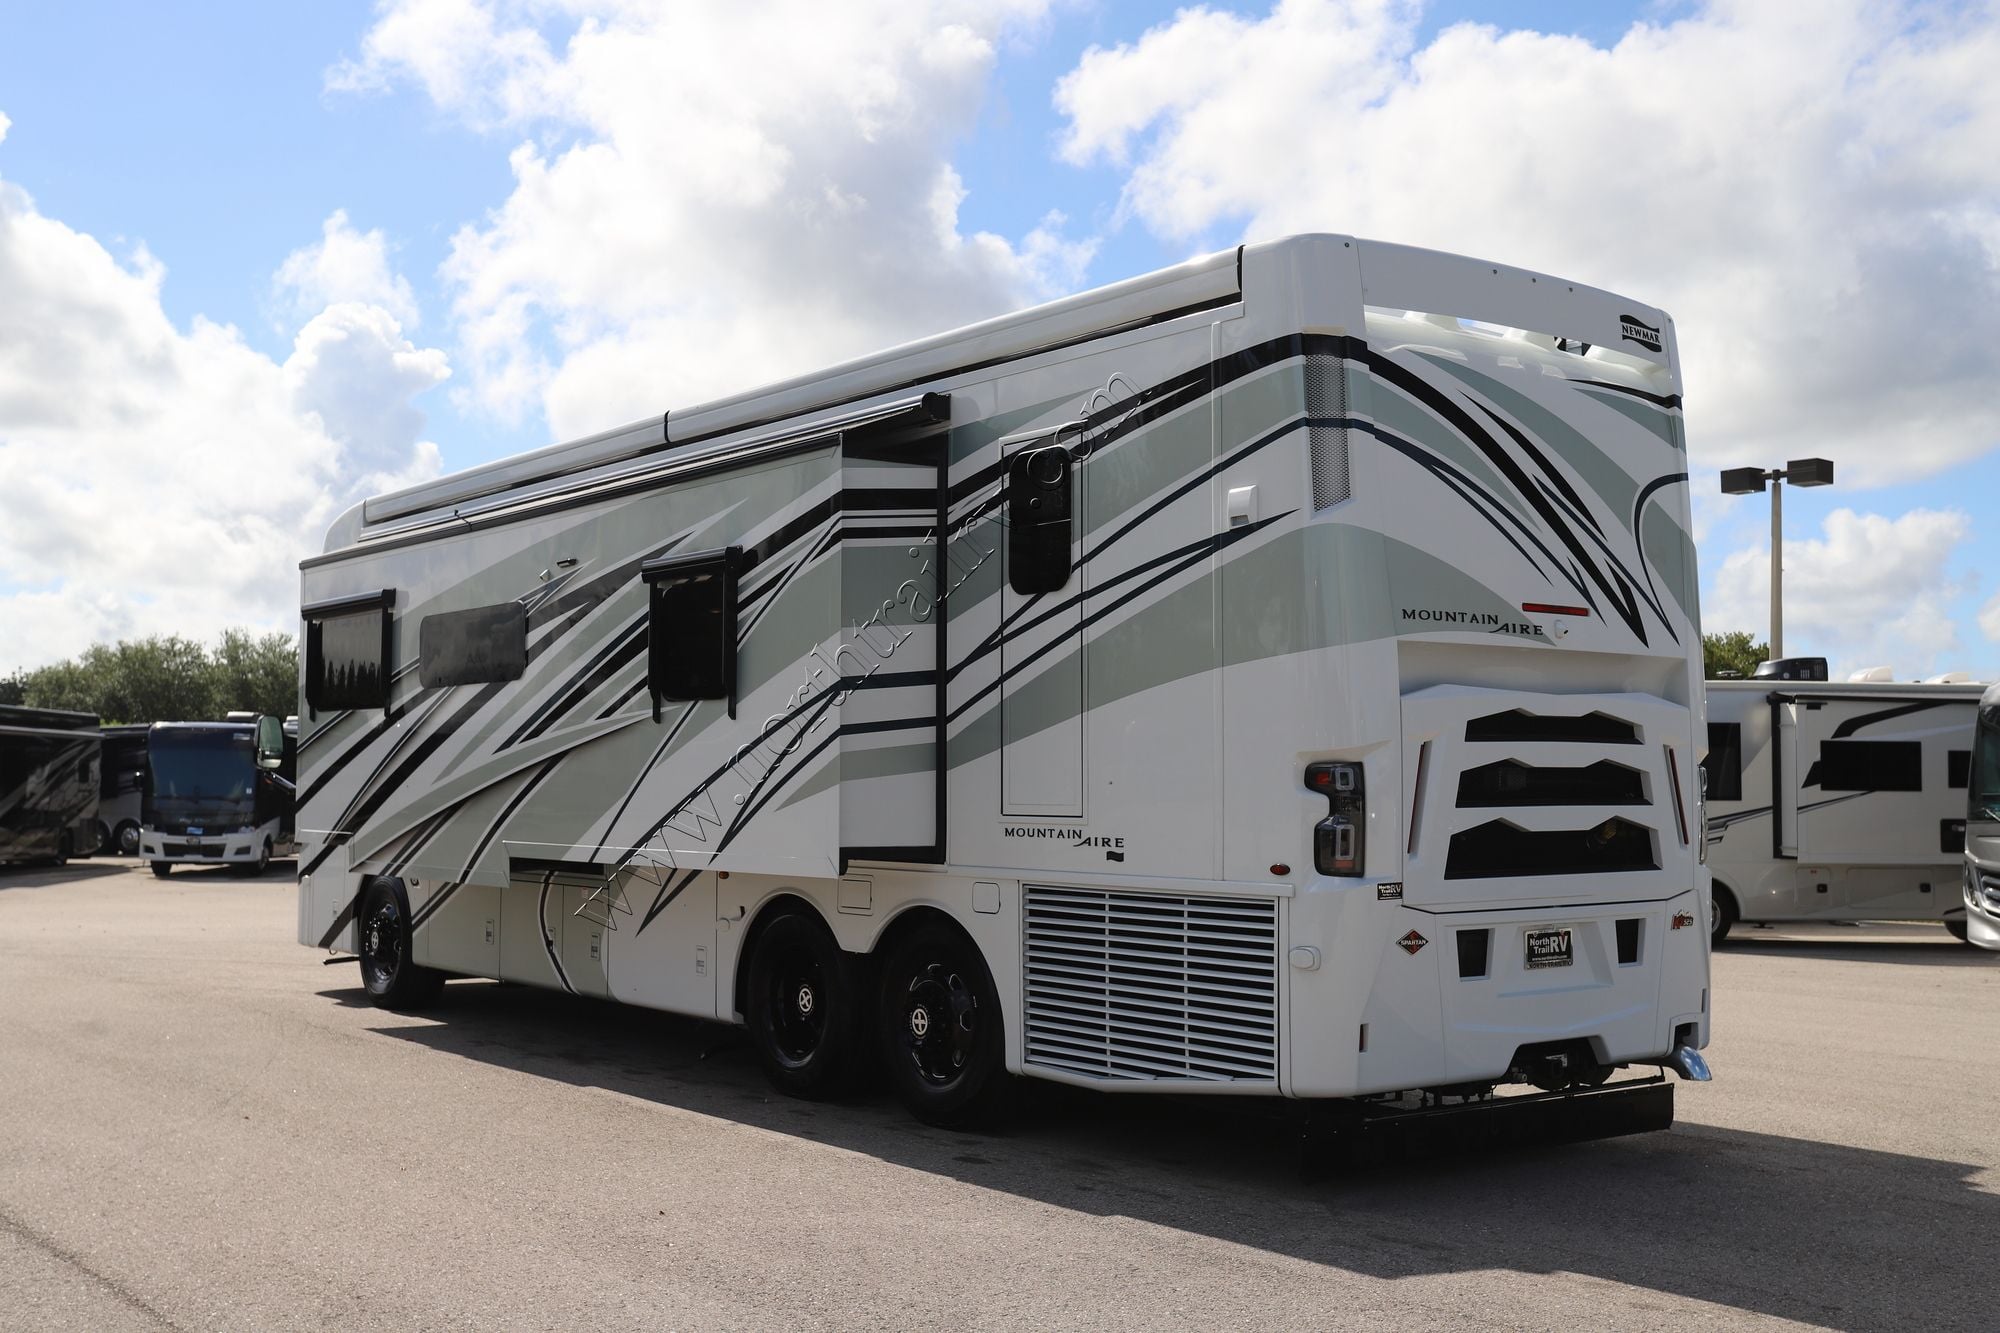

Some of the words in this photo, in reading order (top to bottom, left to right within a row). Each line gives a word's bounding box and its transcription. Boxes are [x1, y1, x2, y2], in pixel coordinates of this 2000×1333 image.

[1622, 324, 1660, 343] NEWMAR
[1402, 609, 1499, 625] MOUNTAIN
[1489, 622, 1543, 636] AIRE
[1004, 827, 1082, 839] MOUNTAIN
[1073, 836, 1124, 848] AIRE
[1529, 937, 1550, 947] North
[1550, 935, 1568, 953] RV
[1533, 945, 1550, 955] Trail
